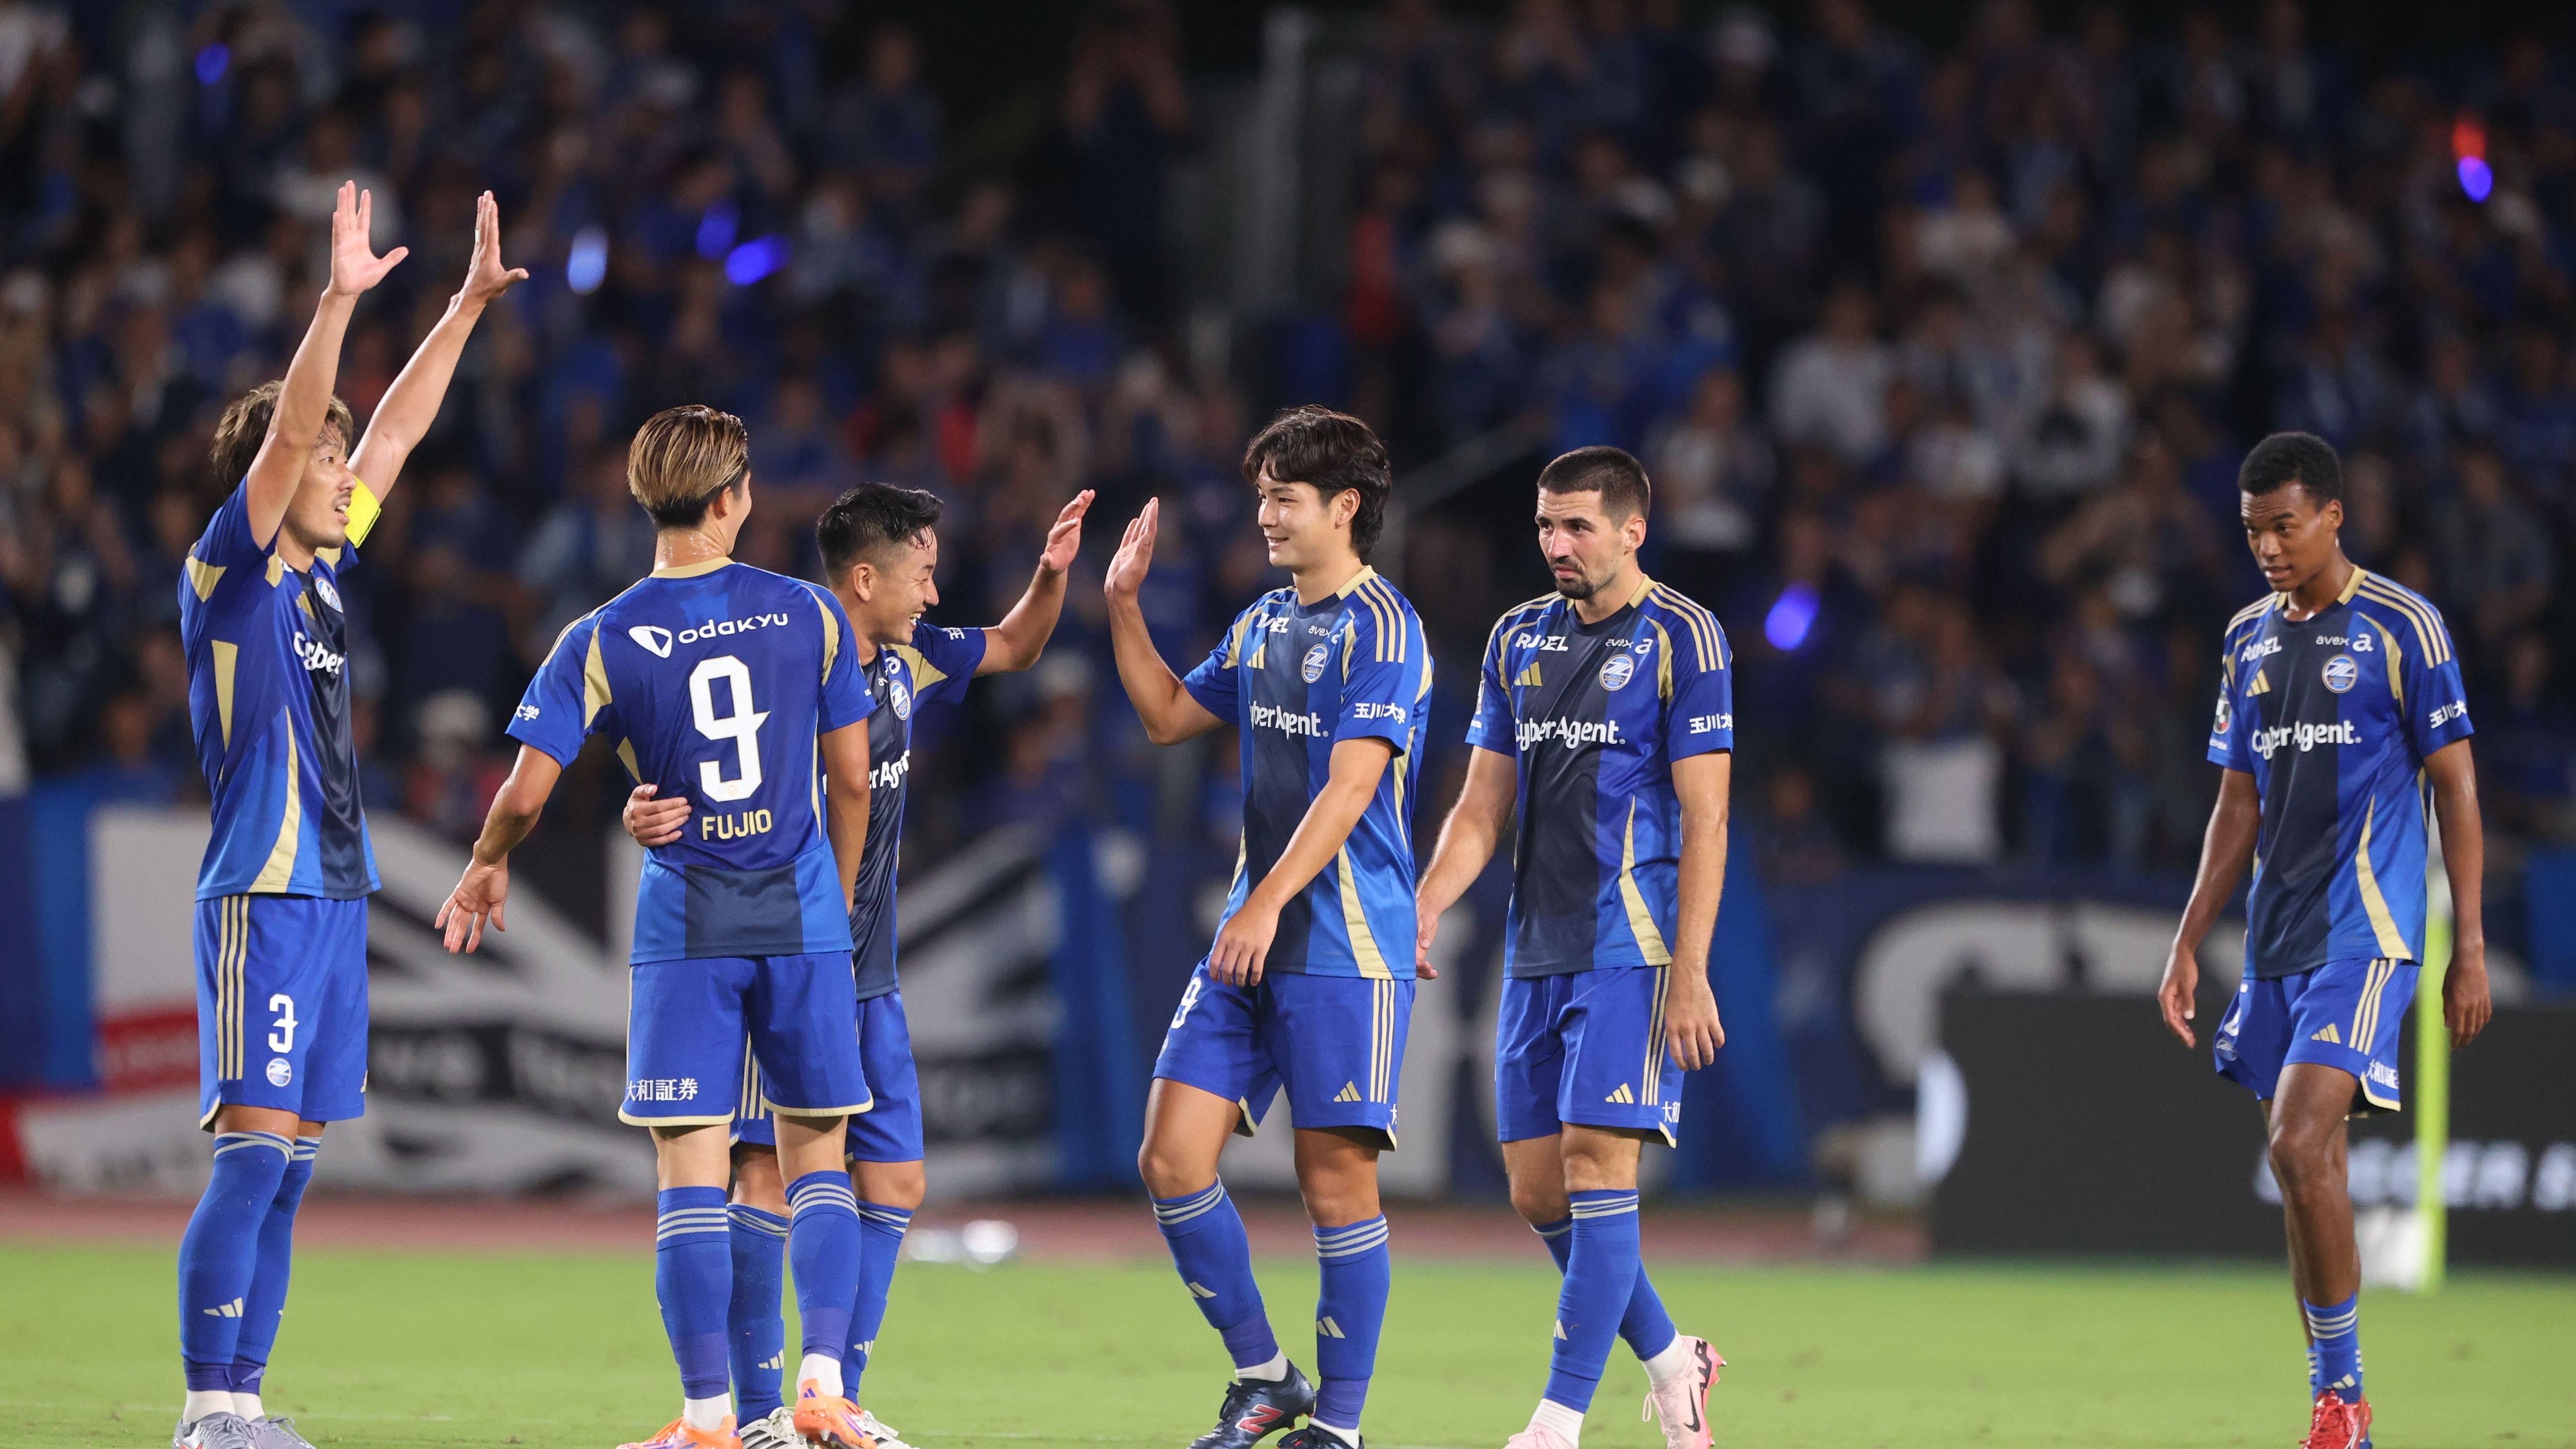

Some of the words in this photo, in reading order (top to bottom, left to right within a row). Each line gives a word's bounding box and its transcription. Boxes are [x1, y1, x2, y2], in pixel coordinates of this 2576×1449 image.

[1308, 625, 1332, 638] avex
[2316, 635, 2350, 646] avex
[689, 655, 771, 802] 9
[702, 809, 772, 841] FUJIO
[268, 993, 299, 1054] 3
[625, 1077, 699, 1102] 大和証券
